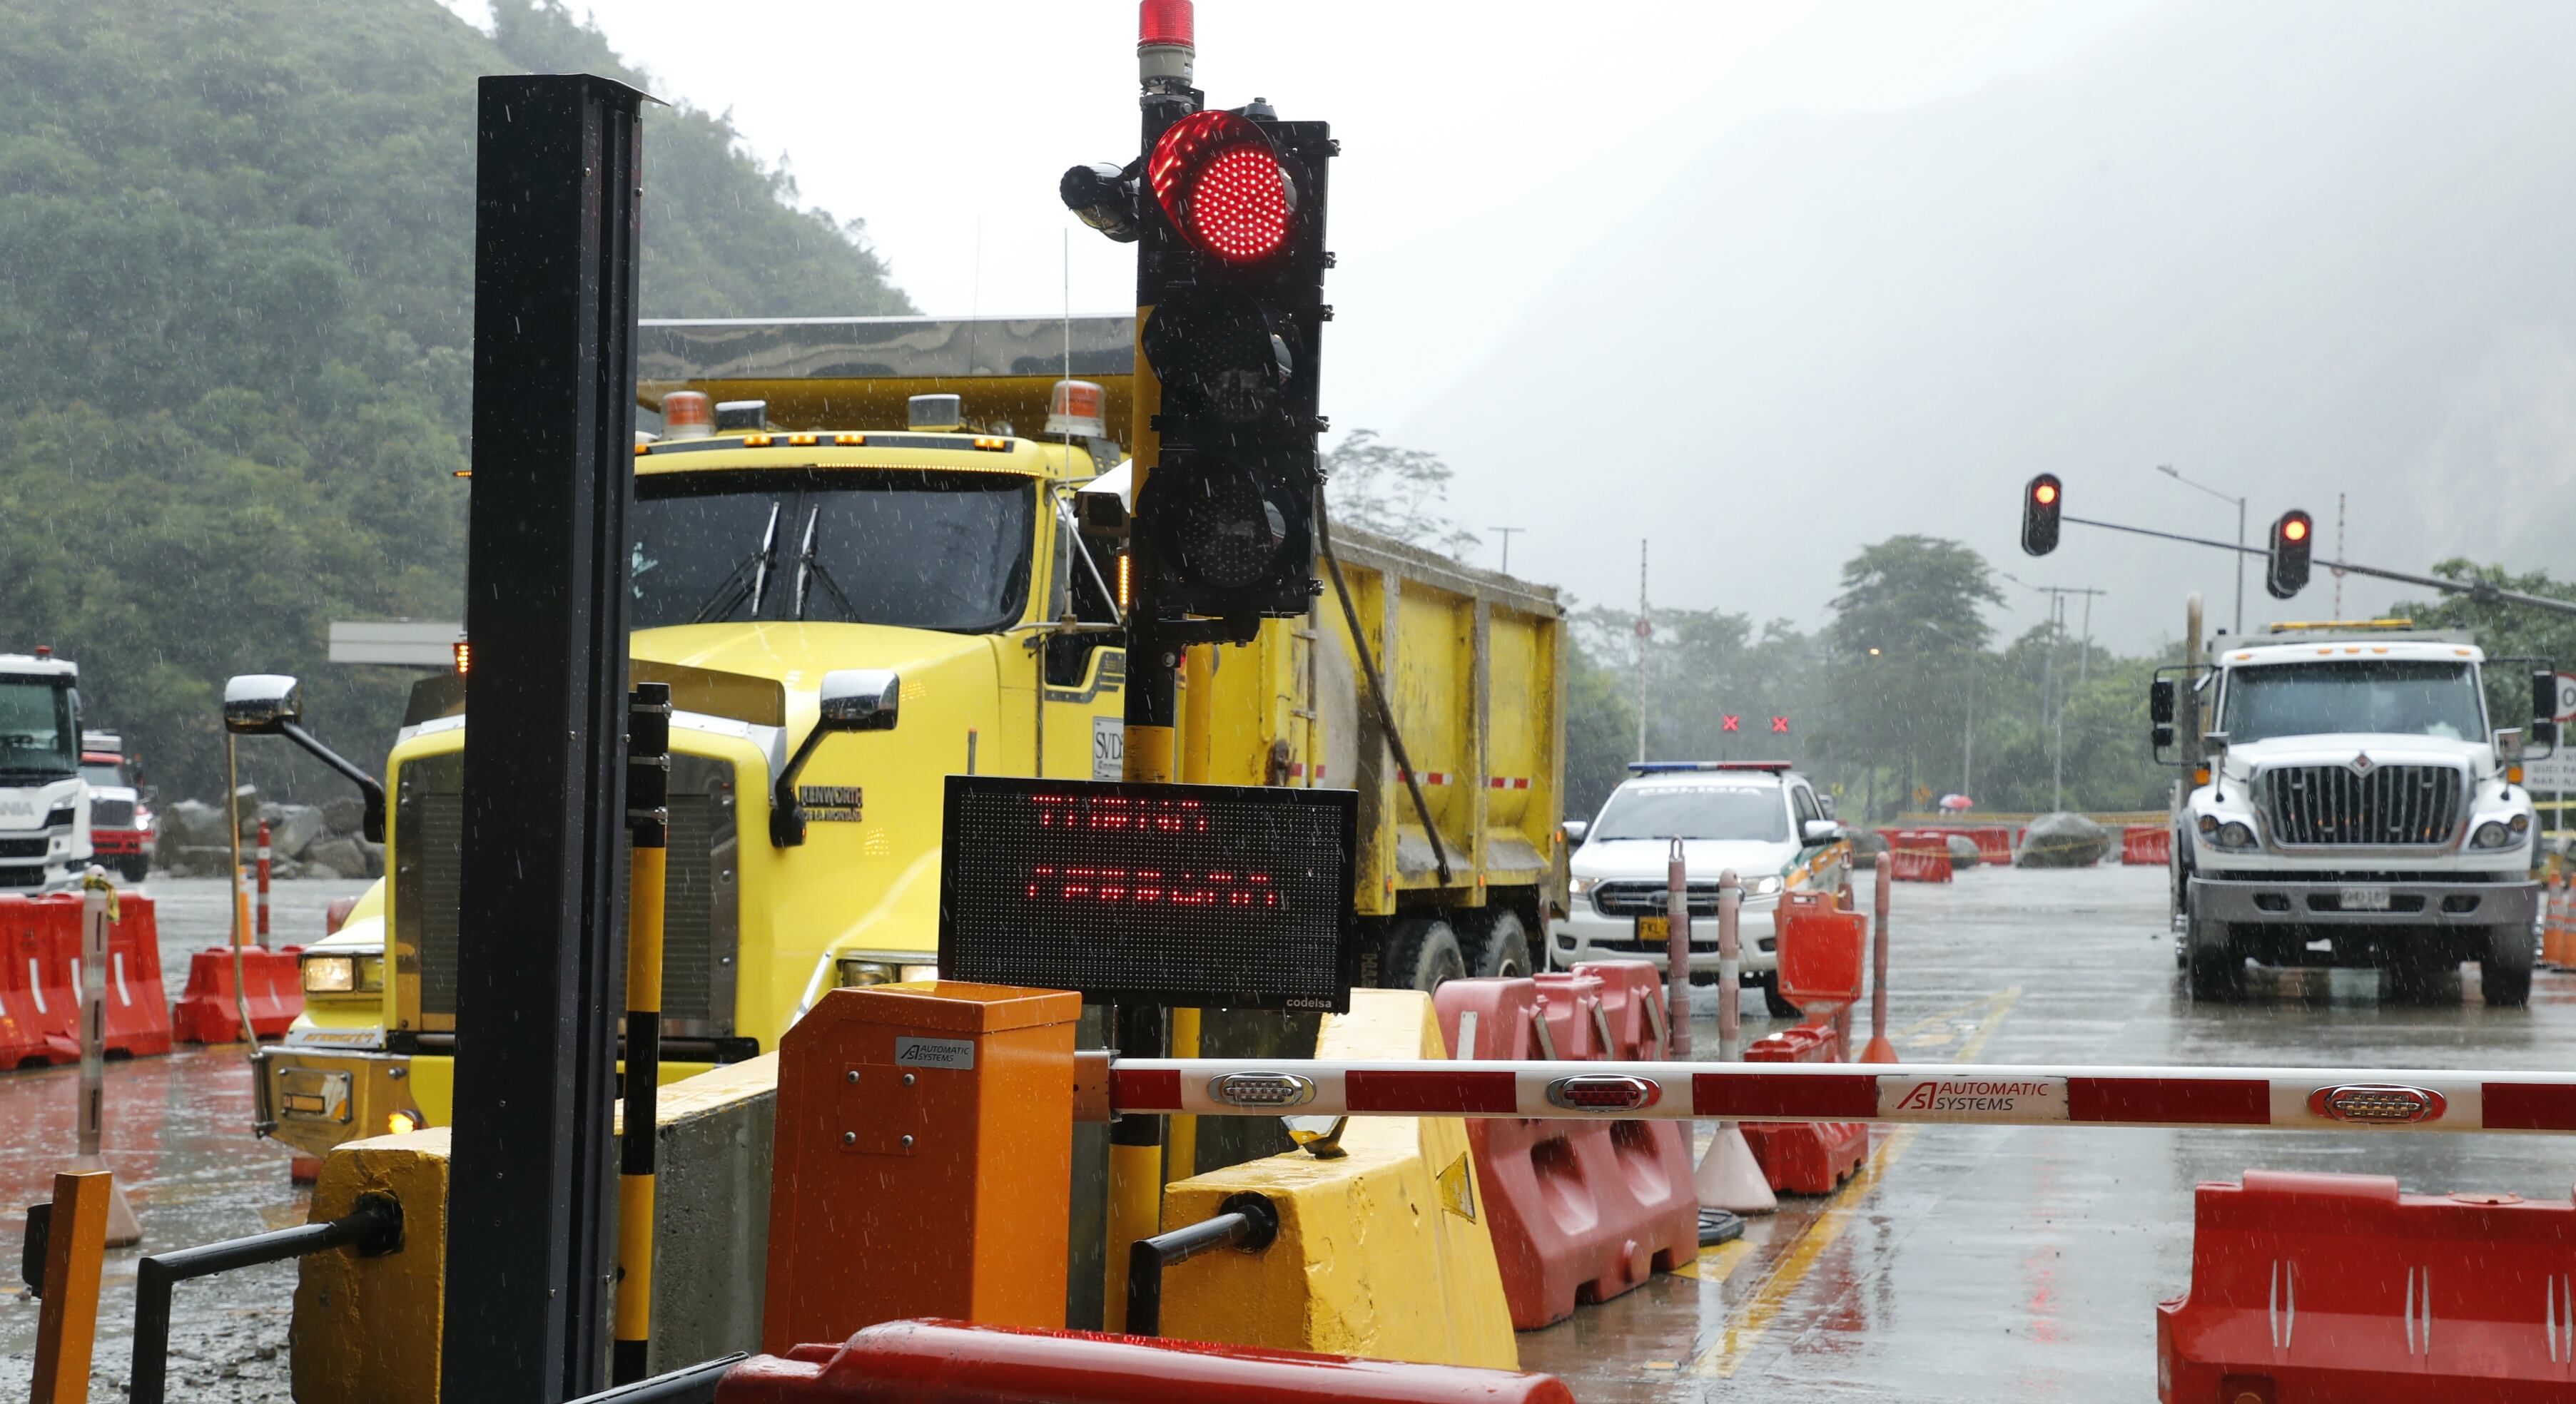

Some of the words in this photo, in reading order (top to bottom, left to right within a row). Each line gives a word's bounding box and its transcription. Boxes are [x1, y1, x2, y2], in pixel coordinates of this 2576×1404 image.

[801, 786, 862, 804] KENWORTH
[1286, 997, 1332, 1008] codelsa
[920, 1044, 970, 1055] AUTOMATIC
[918, 1053, 954, 1062] SYSTEMS
[1939, 1082, 2049, 1096] AUTOMATIC
[1934, 1097, 2014, 1110] SYSTEMS
